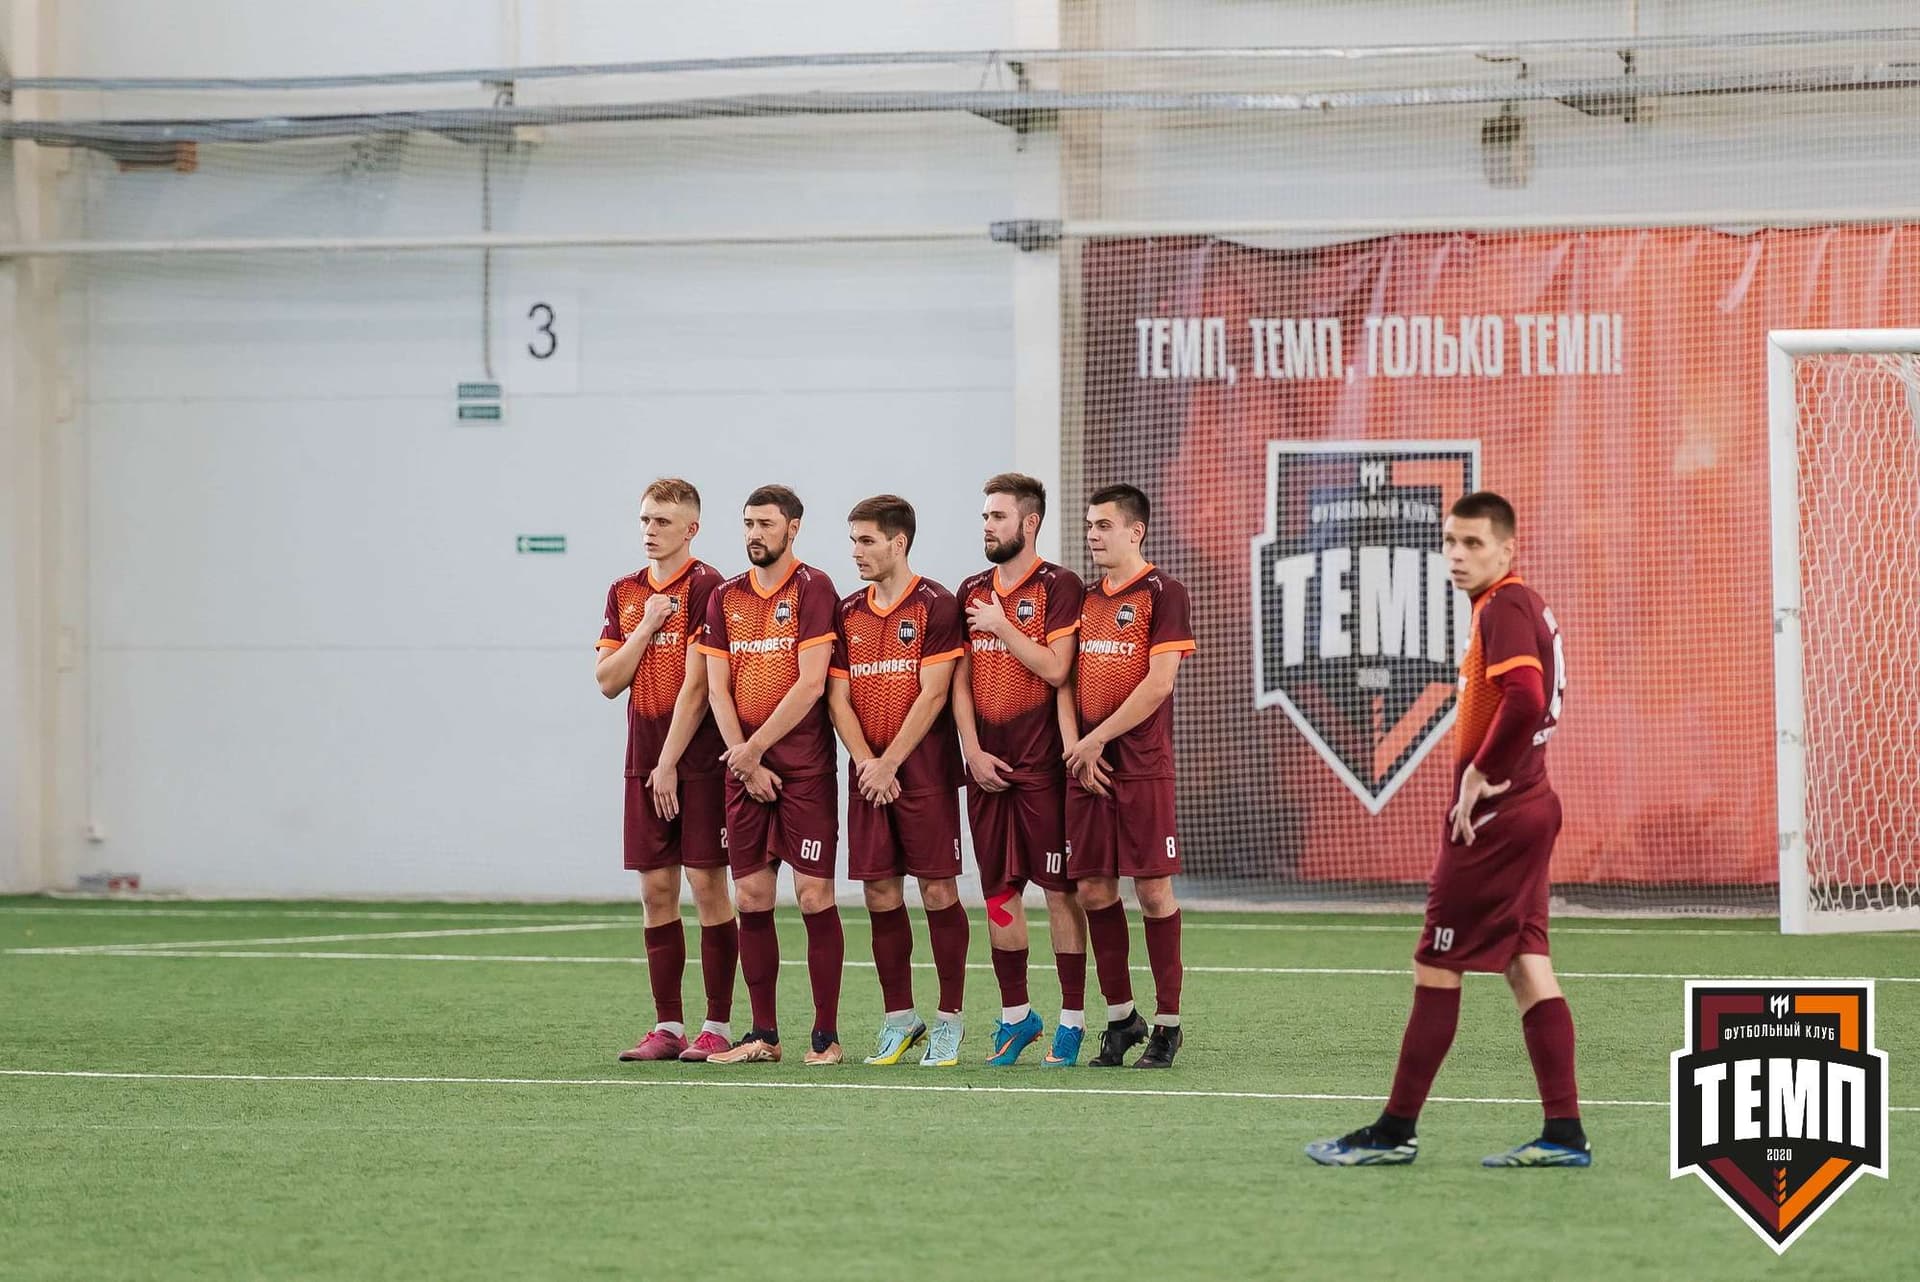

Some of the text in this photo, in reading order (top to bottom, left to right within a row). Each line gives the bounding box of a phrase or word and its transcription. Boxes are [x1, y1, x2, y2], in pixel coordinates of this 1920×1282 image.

[527, 303, 557, 360] 3
[1137, 313, 1623, 385] ТЕМП, ТЕМП, ТОЛЬКО ТЕМП!
[1275, 545, 1472, 668] ТЕМП
[850, 658, 919, 680] ПРОДИНВЕСТ
[801, 838, 822, 861] 60
[1165, 836, 1176, 858] 8
[1046, 852, 1062, 874] 10
[1433, 926, 1455, 952] 19
